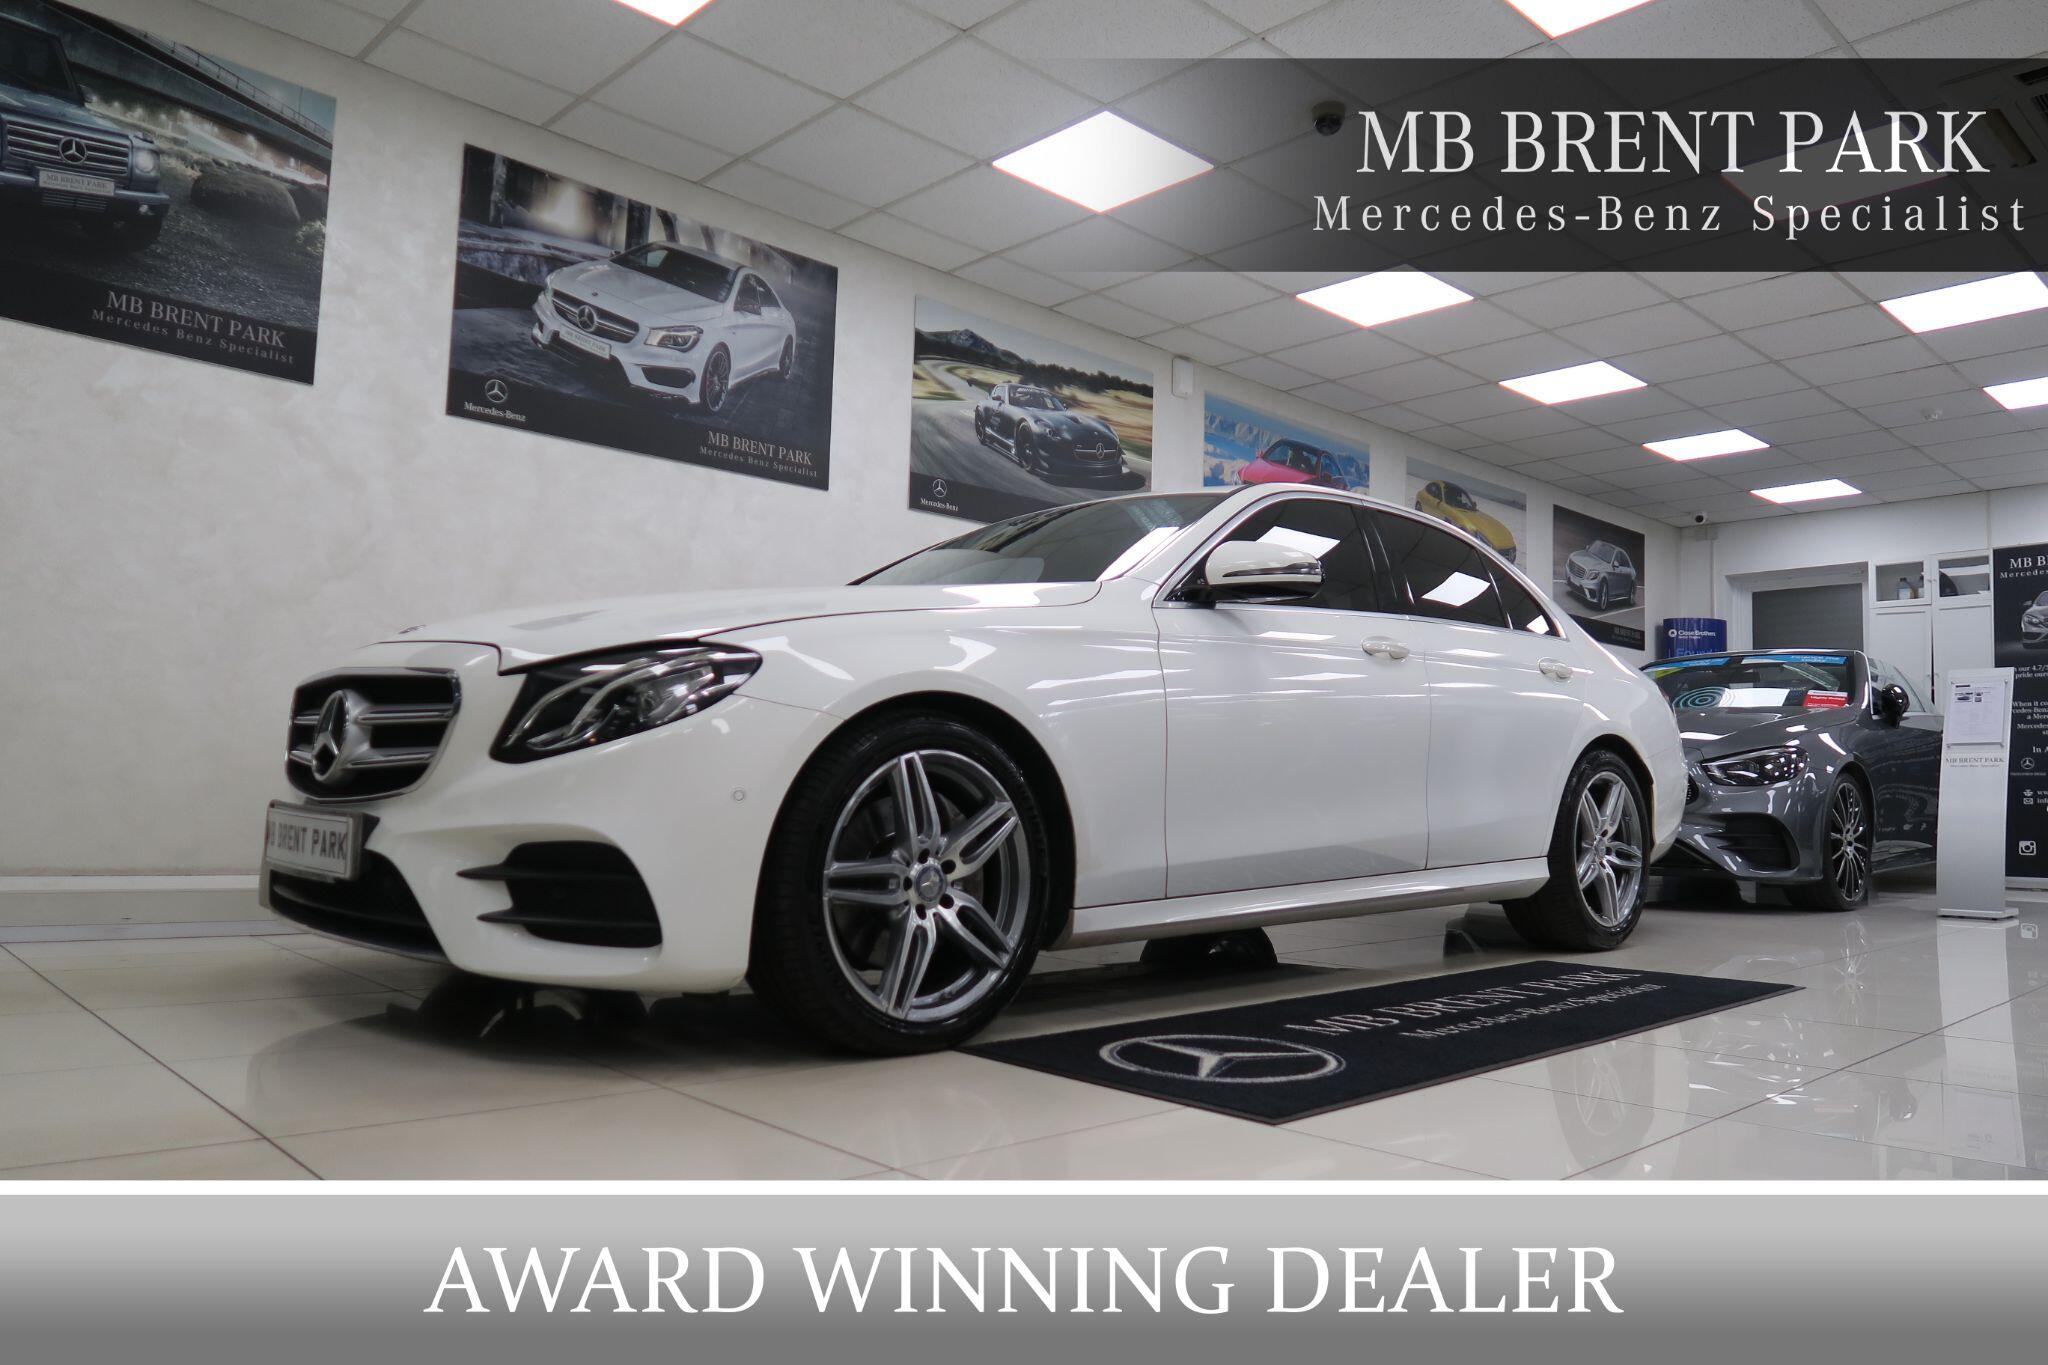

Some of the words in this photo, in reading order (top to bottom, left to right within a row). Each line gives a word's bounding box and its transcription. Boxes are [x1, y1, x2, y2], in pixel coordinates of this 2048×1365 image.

[91, 309, 168, 336] Mercedes
[176, 328, 213, 346] Benz
[219, 338, 294, 365] Specialist
[107, 290, 143, 315] MB
[151, 301, 224, 333] BRENT
[229, 320, 287, 349] PARK
[464, 401, 527, 421] Mercedes-Benz
[700, 446, 744, 462] Mercedes
[748, 456, 769, 468] Benz
[773, 461, 817, 477] Specialist
[708, 430, 729, 447] MB
[733, 436, 776, 458] BRENT
[779, 446, 812, 466] PARK
[920, 497, 959, 511] Mercedes-Benz
[2010, 557, 2032, 568] MB
[277, 821, 308, 855] BRENT
[311, 828, 348, 860] PARK
[1284, 1014, 1400, 1036] MB
[1372, 986, 1546, 1018] BRENT
[1519, 970, 1643, 991] PARK
